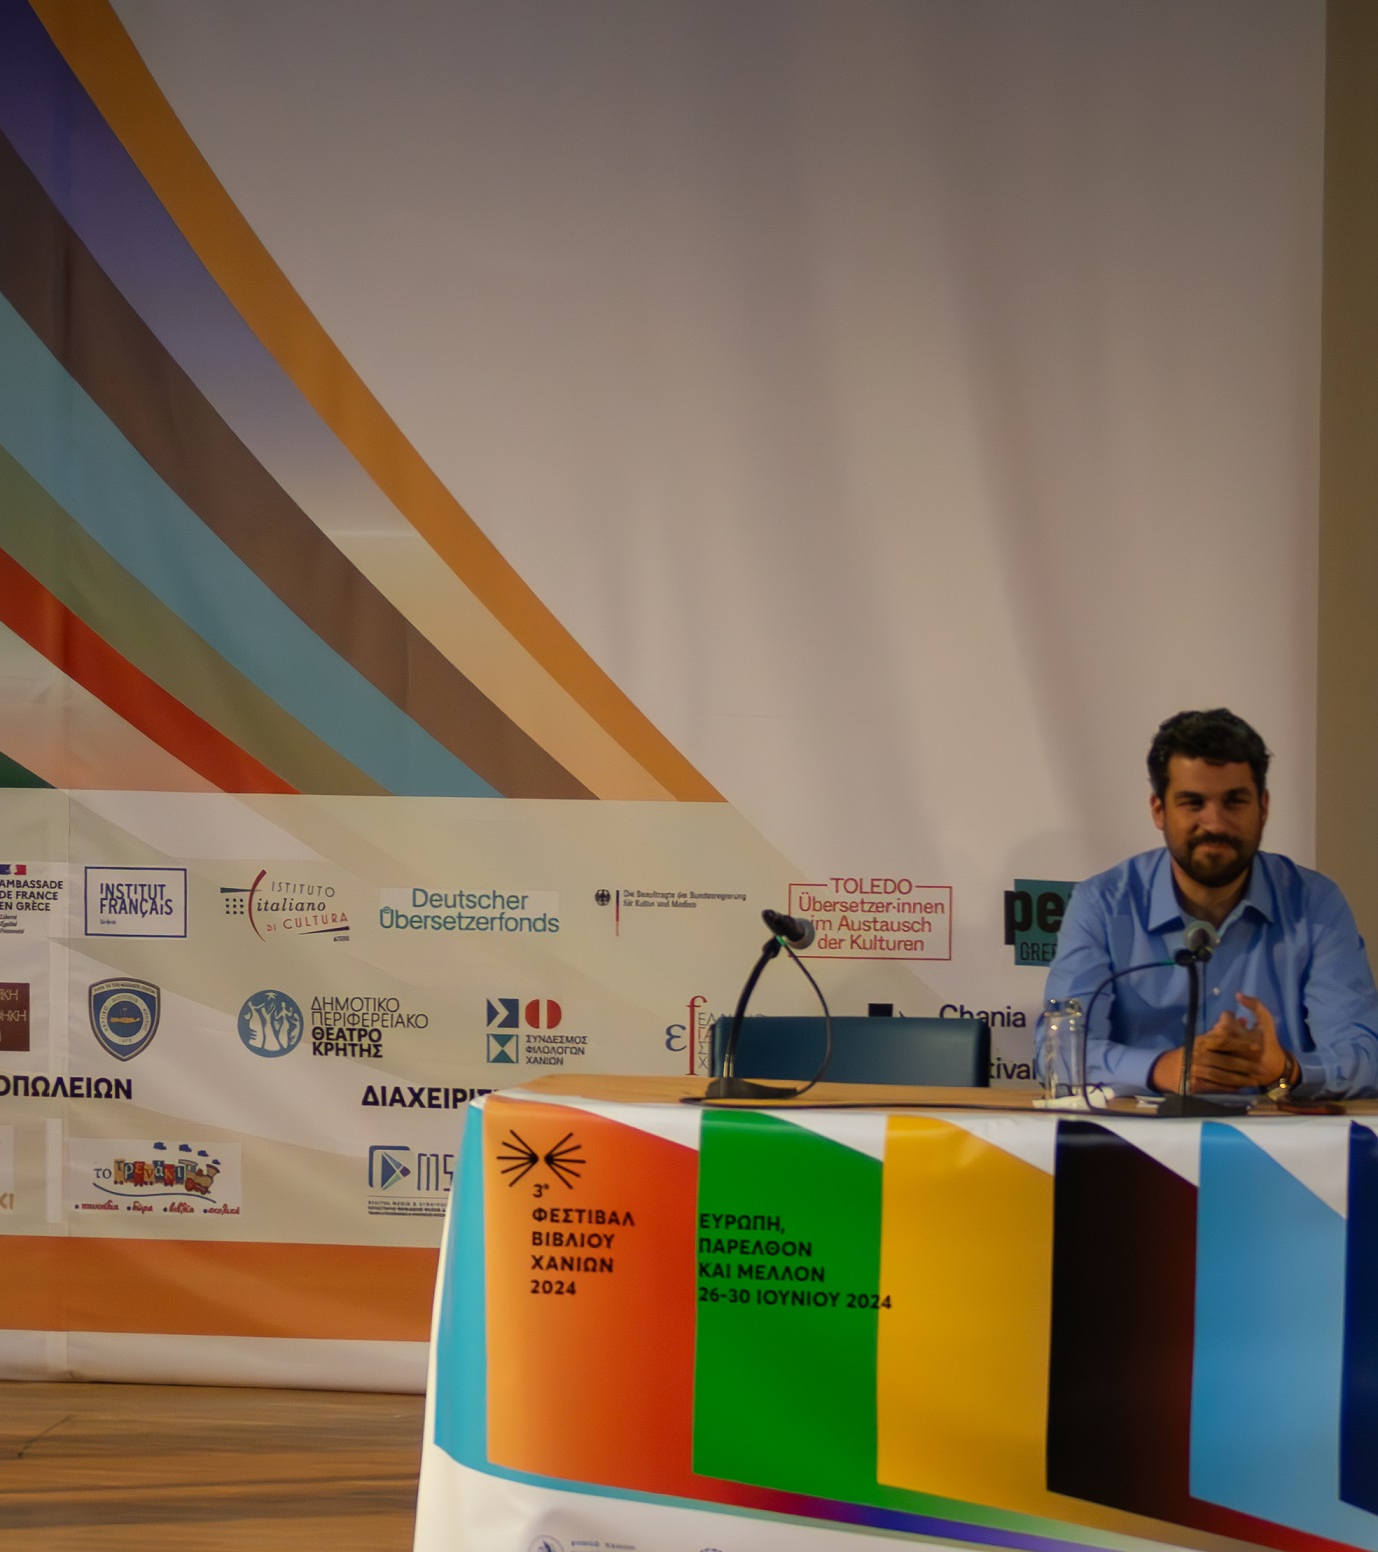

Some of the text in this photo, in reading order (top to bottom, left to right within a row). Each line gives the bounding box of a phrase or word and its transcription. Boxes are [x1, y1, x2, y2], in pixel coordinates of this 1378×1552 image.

[100, 883, 166, 900] INSTITUT
[271, 881, 335, 898] ISTITUTO
[830, 878, 912, 895] TOLEDO
[16, 891, 58, 900] FRANCE
[412, 888, 529, 910] Deutscher
[16, 900, 51, 911] GRÈCE
[257, 898, 326, 912] italiano
[283, 912, 349, 930] CULTURA
[379, 906, 560, 933] Übersetzerfonds
[837, 915, 932, 932] Austausch
[1004, 891, 1069, 945] pe
[817, 934, 925, 951] der Kulturen
[311, 996, 400, 1012] ΔΗΜΟΤΙΚΟ
[311, 1011, 429, 1028] ΠΕΡΙΦΕΡΕΙΑΚΟ
[312, 1027, 382, 1043] ΘΕΑΤΡΟ
[525, 1034, 588, 1045] ΣΥΝΔΕΣΜΟΣ
[312, 1042, 383, 1058] ΚΡΗΤΗΣ
[525, 1045, 585, 1055] ΦΙΛΟΛΟΓΩΝ
[525, 1056, 564, 1066] ΧΑΝΙΩΝ
[94, 1168, 112, 1179] το
[532, 1207, 636, 1227] ΦΕΣΤΙΒΑΛ
[699, 1213, 786, 1235] ΕΥΡΩΠΗ,
[532, 1232, 615, 1249] ΒΙΒΛΙΟΥ
[698, 1238, 813, 1258] ΠΑΡΕΛΘΟΝ
[530, 1255, 614, 1273] ΧΑΝΙΩΝ
[698, 1262, 825, 1283] ΚΑΙ ΜΕΛΛΟΝ
[530, 1280, 577, 1296] 2024
[698, 1286, 892, 1311] 26-30 ΙΟΥΝΙΟΥ 2024
